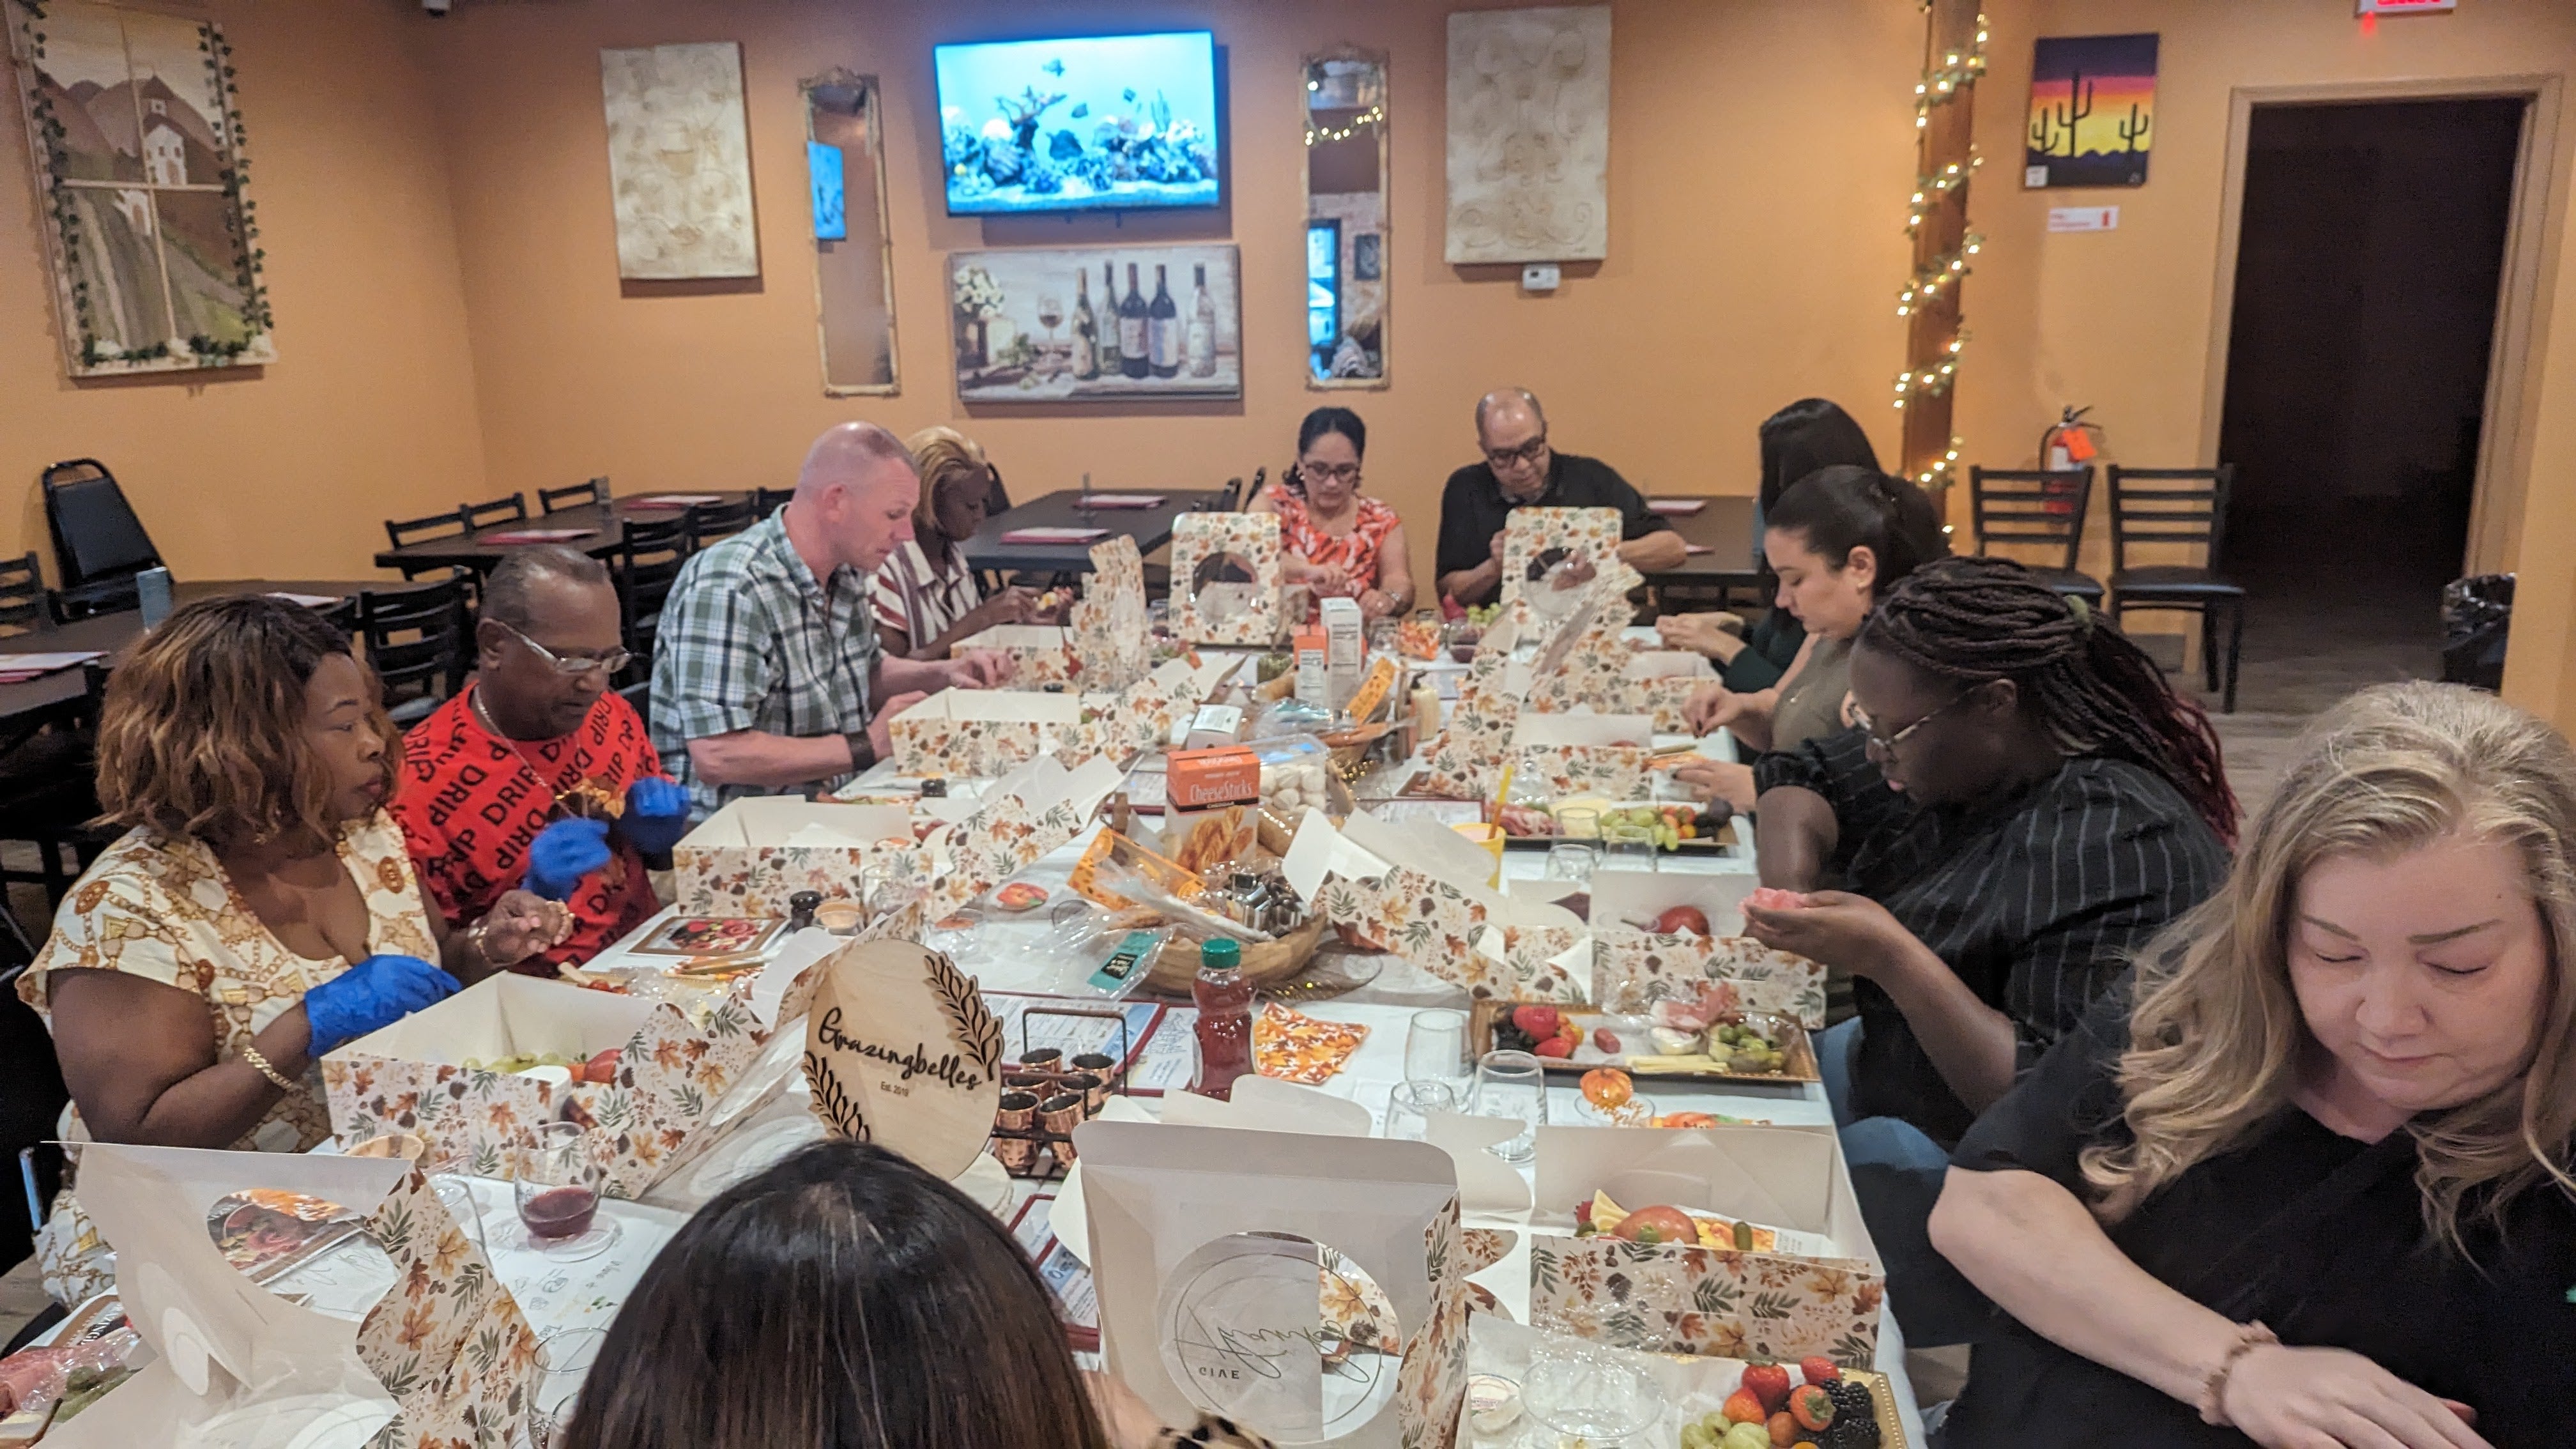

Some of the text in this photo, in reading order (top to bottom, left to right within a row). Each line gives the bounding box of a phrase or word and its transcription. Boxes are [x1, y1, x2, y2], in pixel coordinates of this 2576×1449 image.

[428, 764, 488, 826] DRIP
[480, 765, 536, 827] DRIP
[818, 1006, 983, 1091] Grazingbelles
